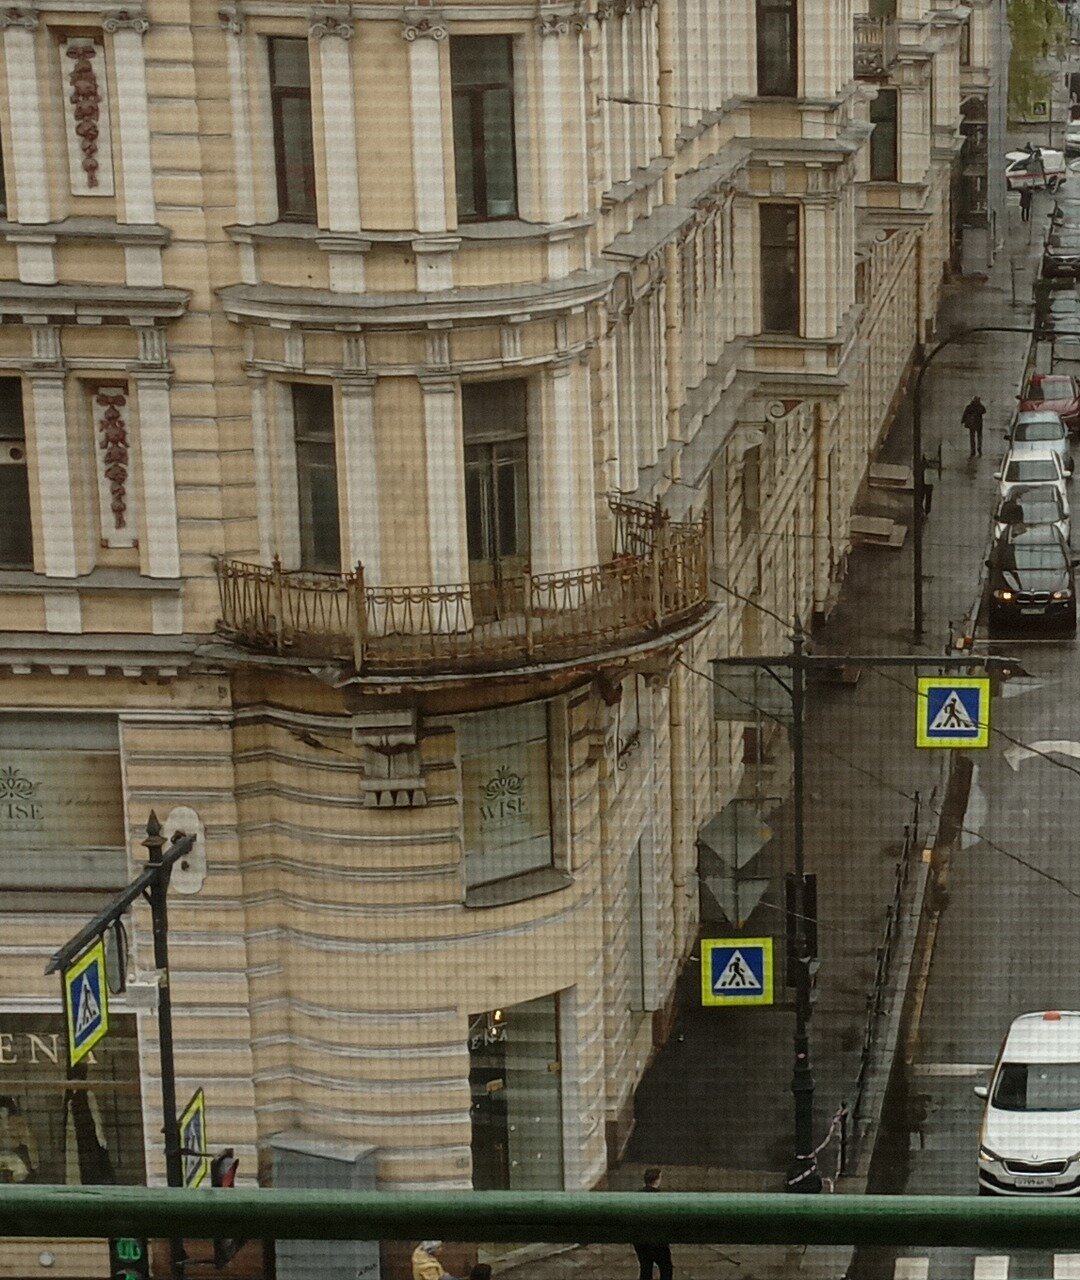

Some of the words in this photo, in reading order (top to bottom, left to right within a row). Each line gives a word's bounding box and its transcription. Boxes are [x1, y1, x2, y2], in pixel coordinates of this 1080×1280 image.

[0, 803, 44, 820] ISE
[479, 797, 529, 821] WISE
[0, 1032, 98, 1065] EN
